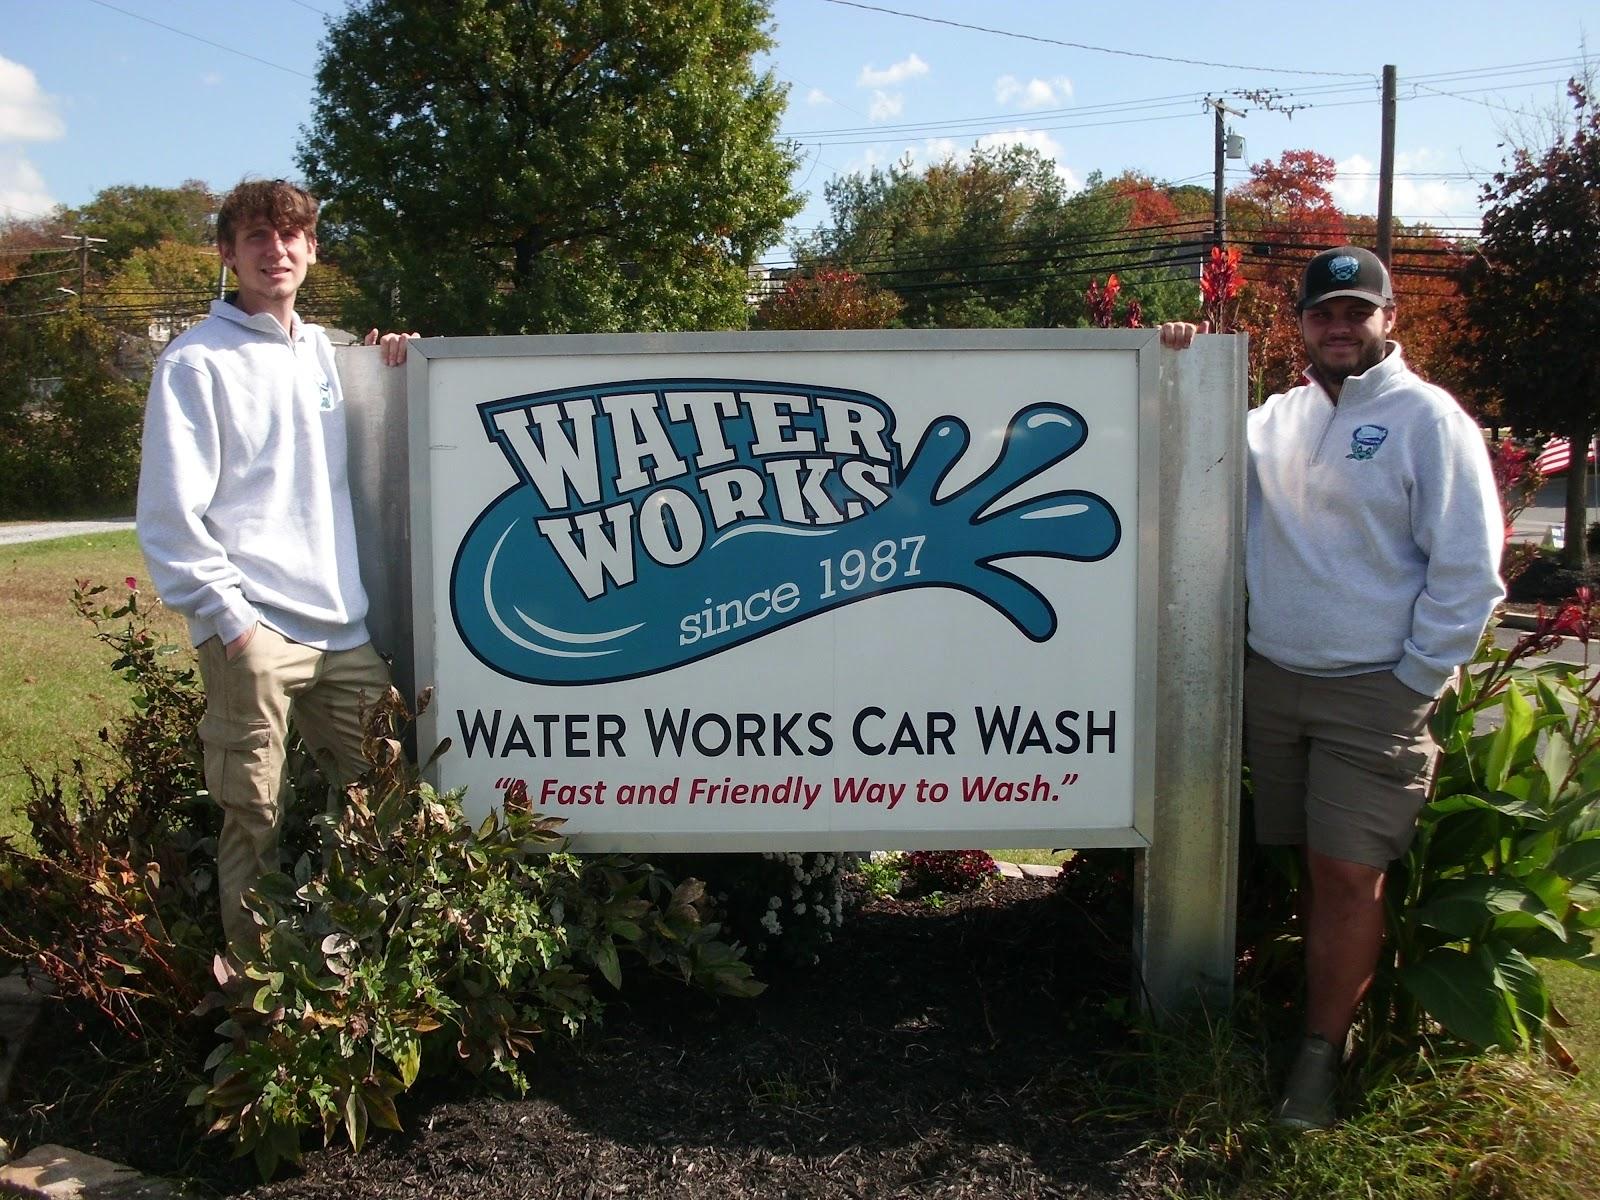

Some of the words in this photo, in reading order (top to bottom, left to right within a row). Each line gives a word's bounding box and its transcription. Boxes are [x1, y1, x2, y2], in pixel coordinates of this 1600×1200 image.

[493, 391, 892, 510] WATER
[541, 457, 891, 600] WORKS
[679, 582, 800, 646] since
[819, 535, 926, 600] 1987
[457, 709, 626, 758] WATER
[644, 708, 833, 757] WORKS
[852, 706, 956, 755] CAR
[974, 705, 1115, 755] WASH
[540, 779, 606, 805] Fast
[616, 778, 680, 805] and
[689, 777, 820, 809] Friendly
[834, 777, 905, 808] Way
[917, 780, 947, 804] to
[963, 774, 1078, 803] Wash.”
